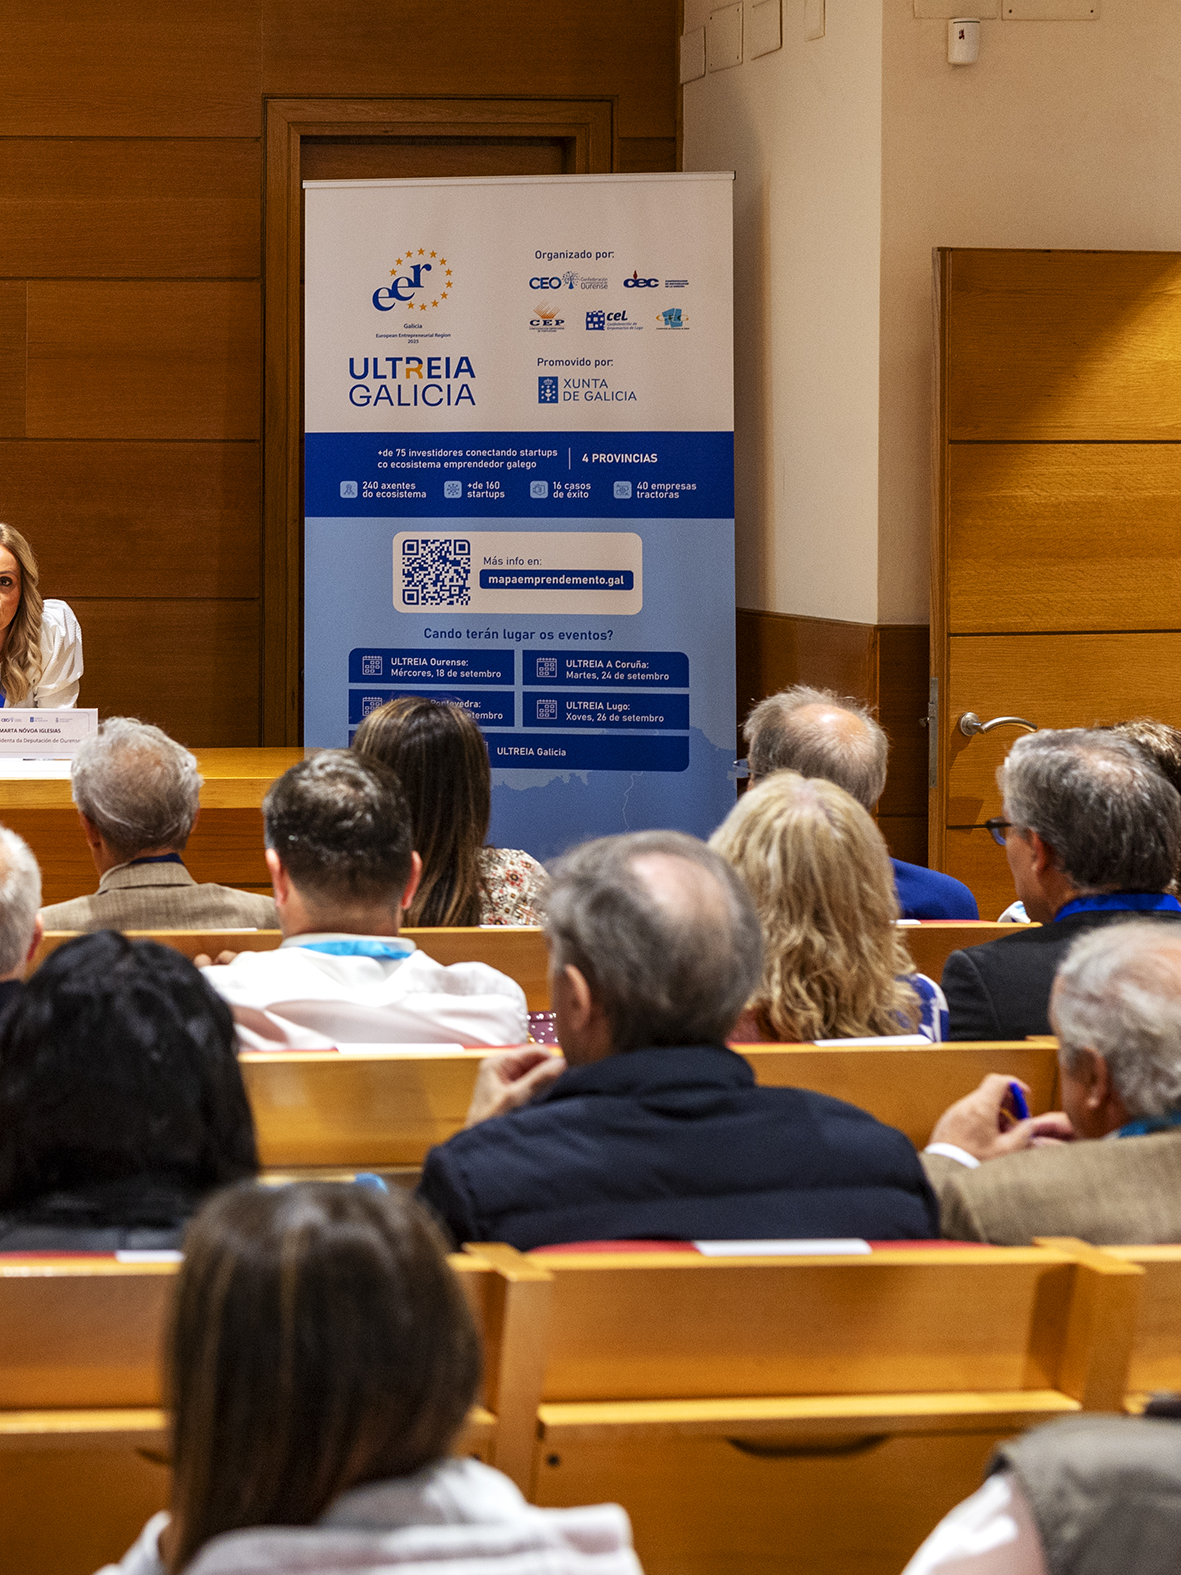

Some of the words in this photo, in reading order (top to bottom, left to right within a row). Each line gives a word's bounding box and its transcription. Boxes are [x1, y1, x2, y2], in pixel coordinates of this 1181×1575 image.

[535, 250, 592, 261] Organizado
[595, 252, 615, 261] por:
[372, 264, 432, 311] eer
[529, 277, 562, 290] CEO
[581, 282, 609, 290] Ourense
[537, 357, 592, 367] Promovido
[595, 359, 614, 368] por:
[349, 356, 476, 380] ULTREIA
[563, 378, 609, 389] XUNTA
[349, 384, 476, 407] GALICIA
[563, 391, 580, 401] DE
[584, 391, 638, 401] GALICIA
[378, 449, 394, 457] +de
[395, 449, 406, 457] 75
[409, 449, 464, 457] investidores
[465, 449, 518, 457] conectando
[519, 450, 558, 459] startups
[581, 454, 589, 463] 4
[592, 454, 658, 463] PROVINCIAS
[377, 461, 388, 469] co
[391, 460, 441, 469] ecosistema
[443, 460, 505, 470] emprendedor
[506, 460, 537, 470] galego
[362, 481, 379, 490] 240
[381, 482, 416, 490] axentes
[467, 482, 484, 490] +de
[486, 482, 500, 490] 160
[553, 481, 562, 490] 16
[565, 482, 591, 490] casos
[637, 482, 649, 491] 40
[651, 483, 697, 492] empresas
[362, 490, 374, 498] do
[375, 490, 427, 499] ecosistema
[467, 490, 505, 499] startups
[553, 490, 564, 499] de
[567, 488, 589, 499] éxito
[637, 490, 680, 499] tractoras
[483, 556, 504, 566] Más
[506, 556, 525, 566] info
[527, 558, 542, 566] en:
[488, 574, 625, 587] mapaemprendemento.gal
[424, 628, 463, 640] Cando
[466, 628, 499, 640] terán
[503, 629, 536, 642] lugar
[539, 632, 554, 640] os
[558, 630, 614, 641] eventos?
[391, 658, 428, 666] ULTREIA
[430, 658, 469, 666] Ourense:
[566, 660, 604, 668] ULTREIA
[606, 660, 613, 668] A
[615, 660, 649, 669] Coruña:
[391, 668, 434, 678] Mércores,
[460, 670, 502, 678] setembro
[566, 672, 600, 680] Martes,
[601, 672, 612, 680] 24
[613, 672, 625, 680] de
[627, 672, 670, 681] setembro
[566, 702, 604, 710] ULTREIA
[607, 702, 631, 712] Lugo:
[467, 712, 504, 720] etembro
[566, 712, 595, 722] Xoves,
[597, 712, 607, 721] 26
[609, 713, 620, 721] de
[622, 714, 664, 723] setembro
[497, 748, 535, 756] ULTREIA
[537, 748, 567, 757] Galicia
